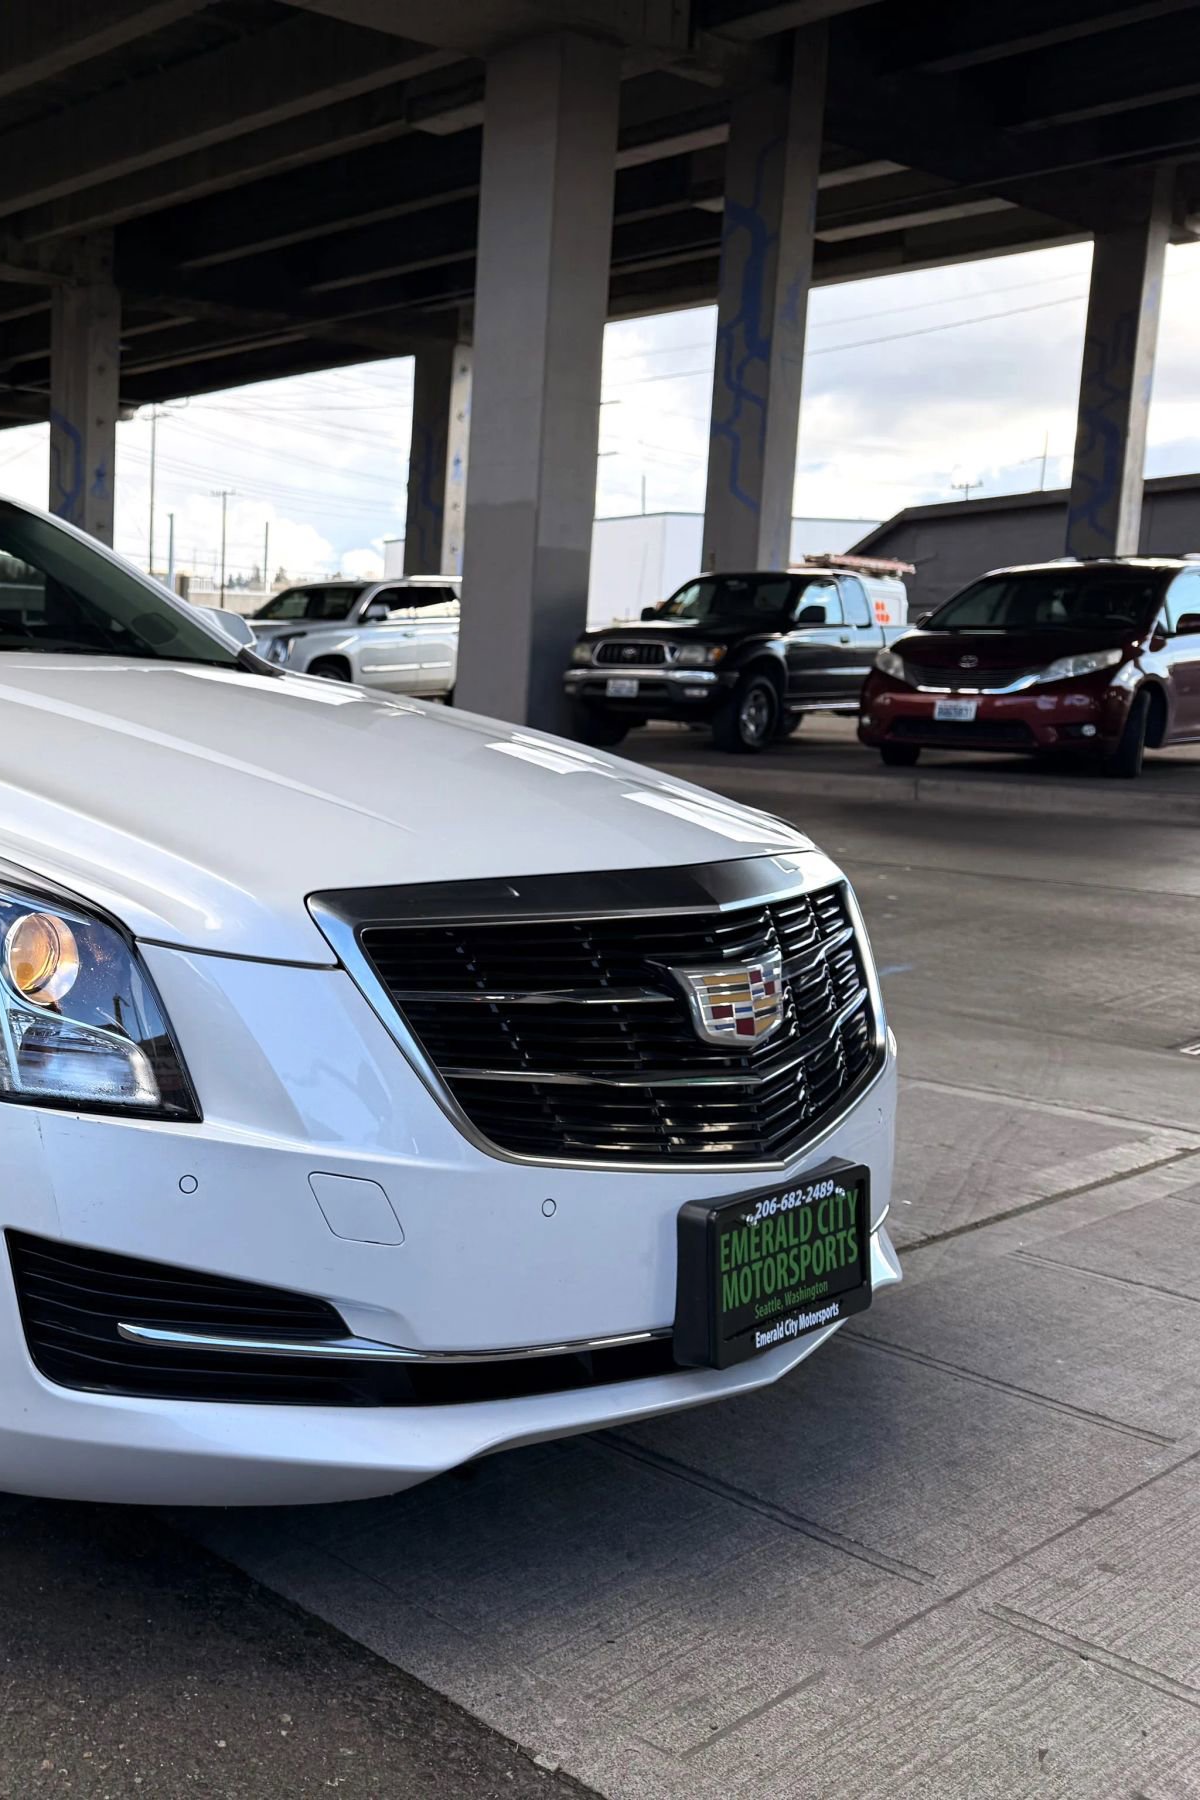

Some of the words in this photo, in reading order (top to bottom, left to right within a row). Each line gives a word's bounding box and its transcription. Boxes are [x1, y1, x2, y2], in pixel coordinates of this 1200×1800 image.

[755, 1179, 835, 1220] 206-682-2489
[720, 1207, 813, 1272] EMERALD
[817, 1189, 859, 1235] CITY
[722, 1227, 858, 1312] MOTORSPORTS
[754, 1296, 783, 1319] Seattle,
[784, 1280, 828, 1308] Washington
[755, 1322, 784, 1348] Emerald
[785, 1317, 798, 1337] City
[798, 1302, 840, 1330] Motorsports
